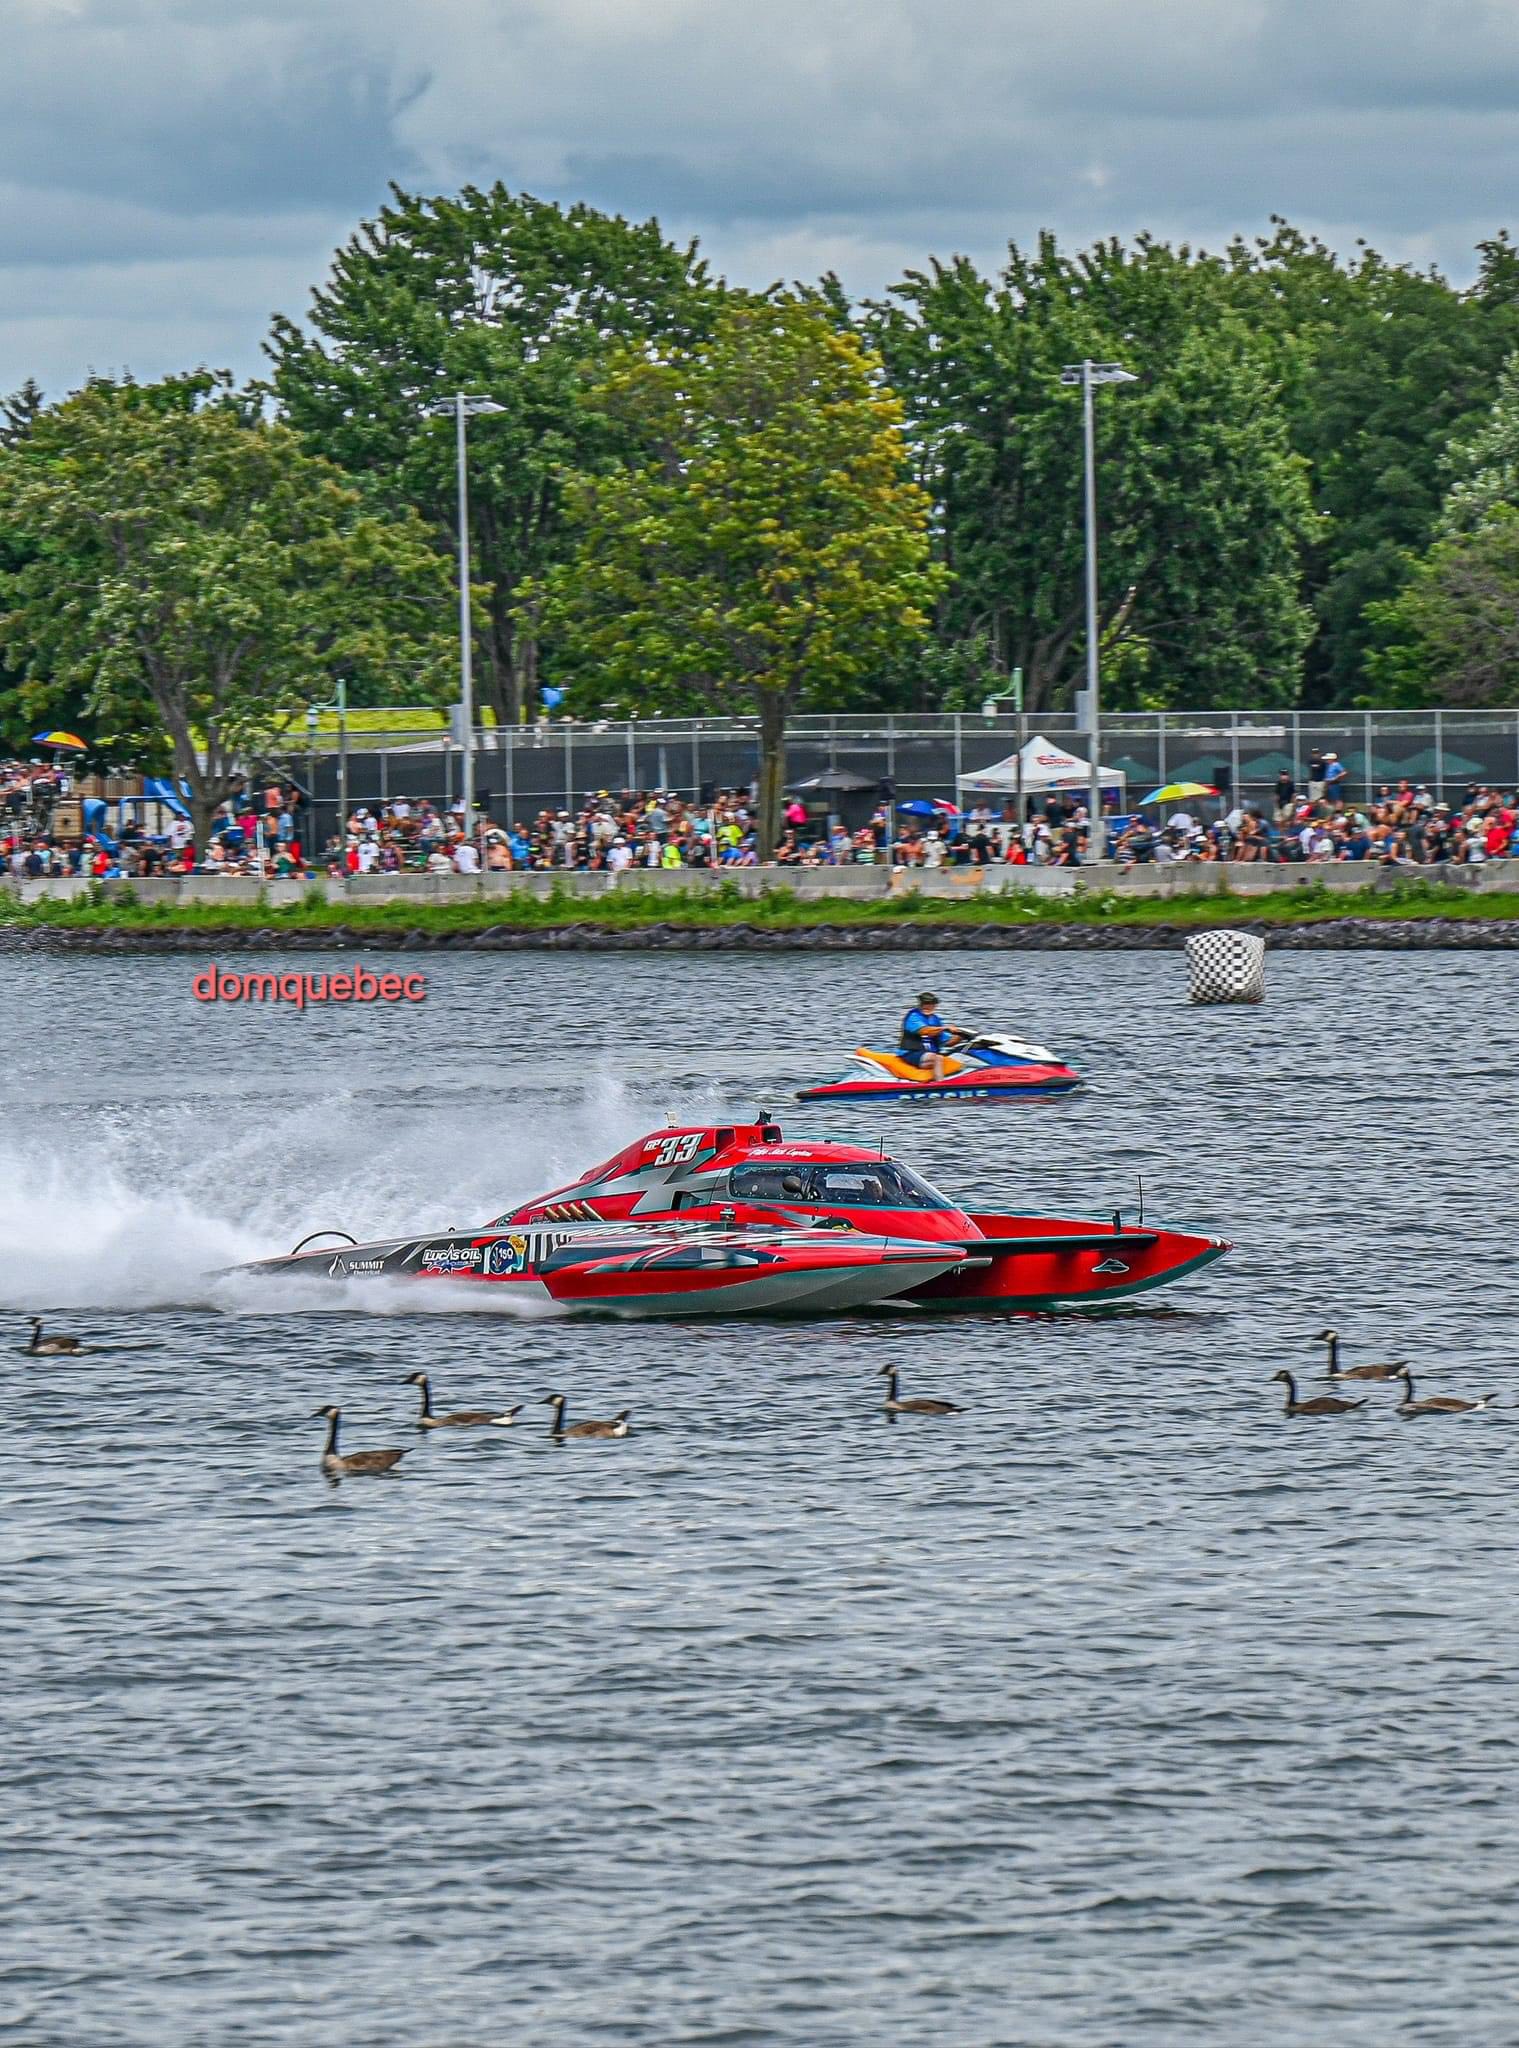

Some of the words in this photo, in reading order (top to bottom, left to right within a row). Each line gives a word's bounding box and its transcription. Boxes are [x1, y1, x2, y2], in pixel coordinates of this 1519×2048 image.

[654, 1133, 706, 1166] 33
[424, 1249, 460, 1261] LUCAS
[460, 1248, 480, 1260] OIL
[349, 1260, 385, 1270] SUMMIT
